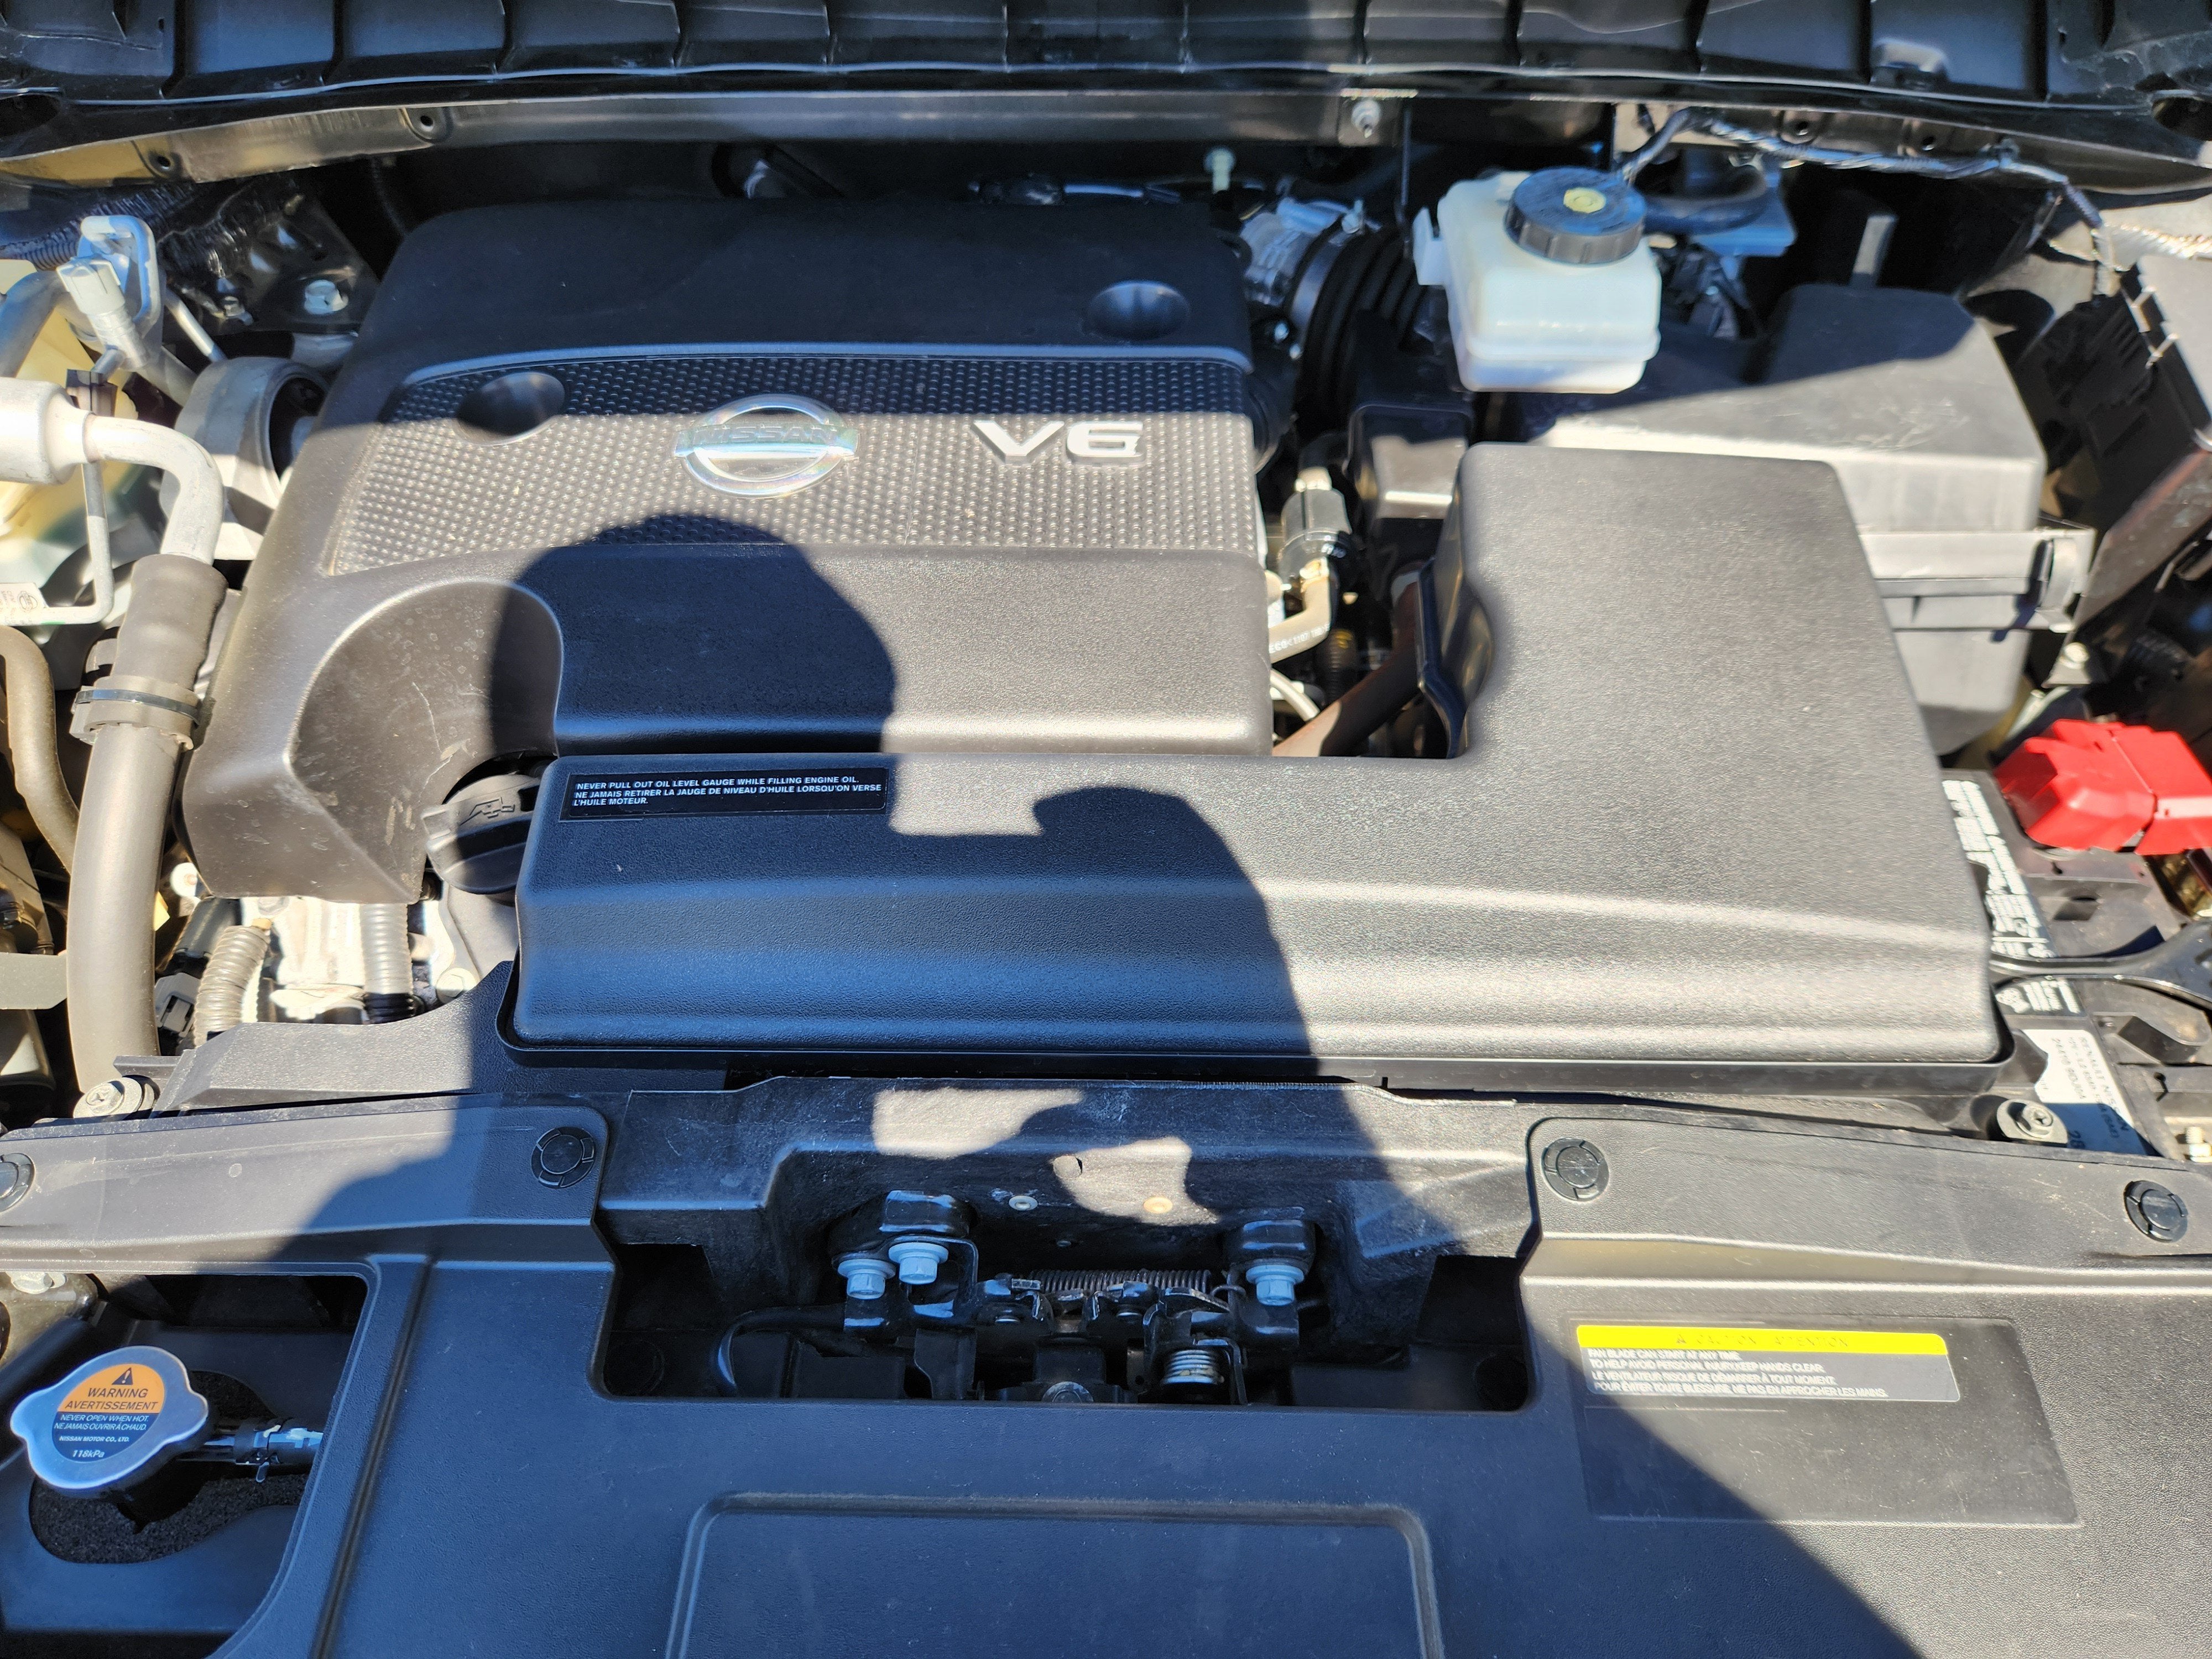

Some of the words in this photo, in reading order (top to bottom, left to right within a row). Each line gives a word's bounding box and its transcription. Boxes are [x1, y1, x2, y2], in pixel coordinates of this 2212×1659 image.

[693, 424, 837, 444] NISSAN
[972, 419, 1144, 460] V6
[576, 782, 607, 790] NEVER
[759, 785, 795, 794] D'HUILE
[797, 785, 850, 793] LORSQU'ON
[1696, 1333, 1757, 1345] CAON
[1774, 1335, 1848, 1348] AENTION
[87, 1387, 148, 1398] WARNING
[65, 1400, 159, 1410] AVERTISSEMENT
[72, 1449, 105, 1458] 118kPa
